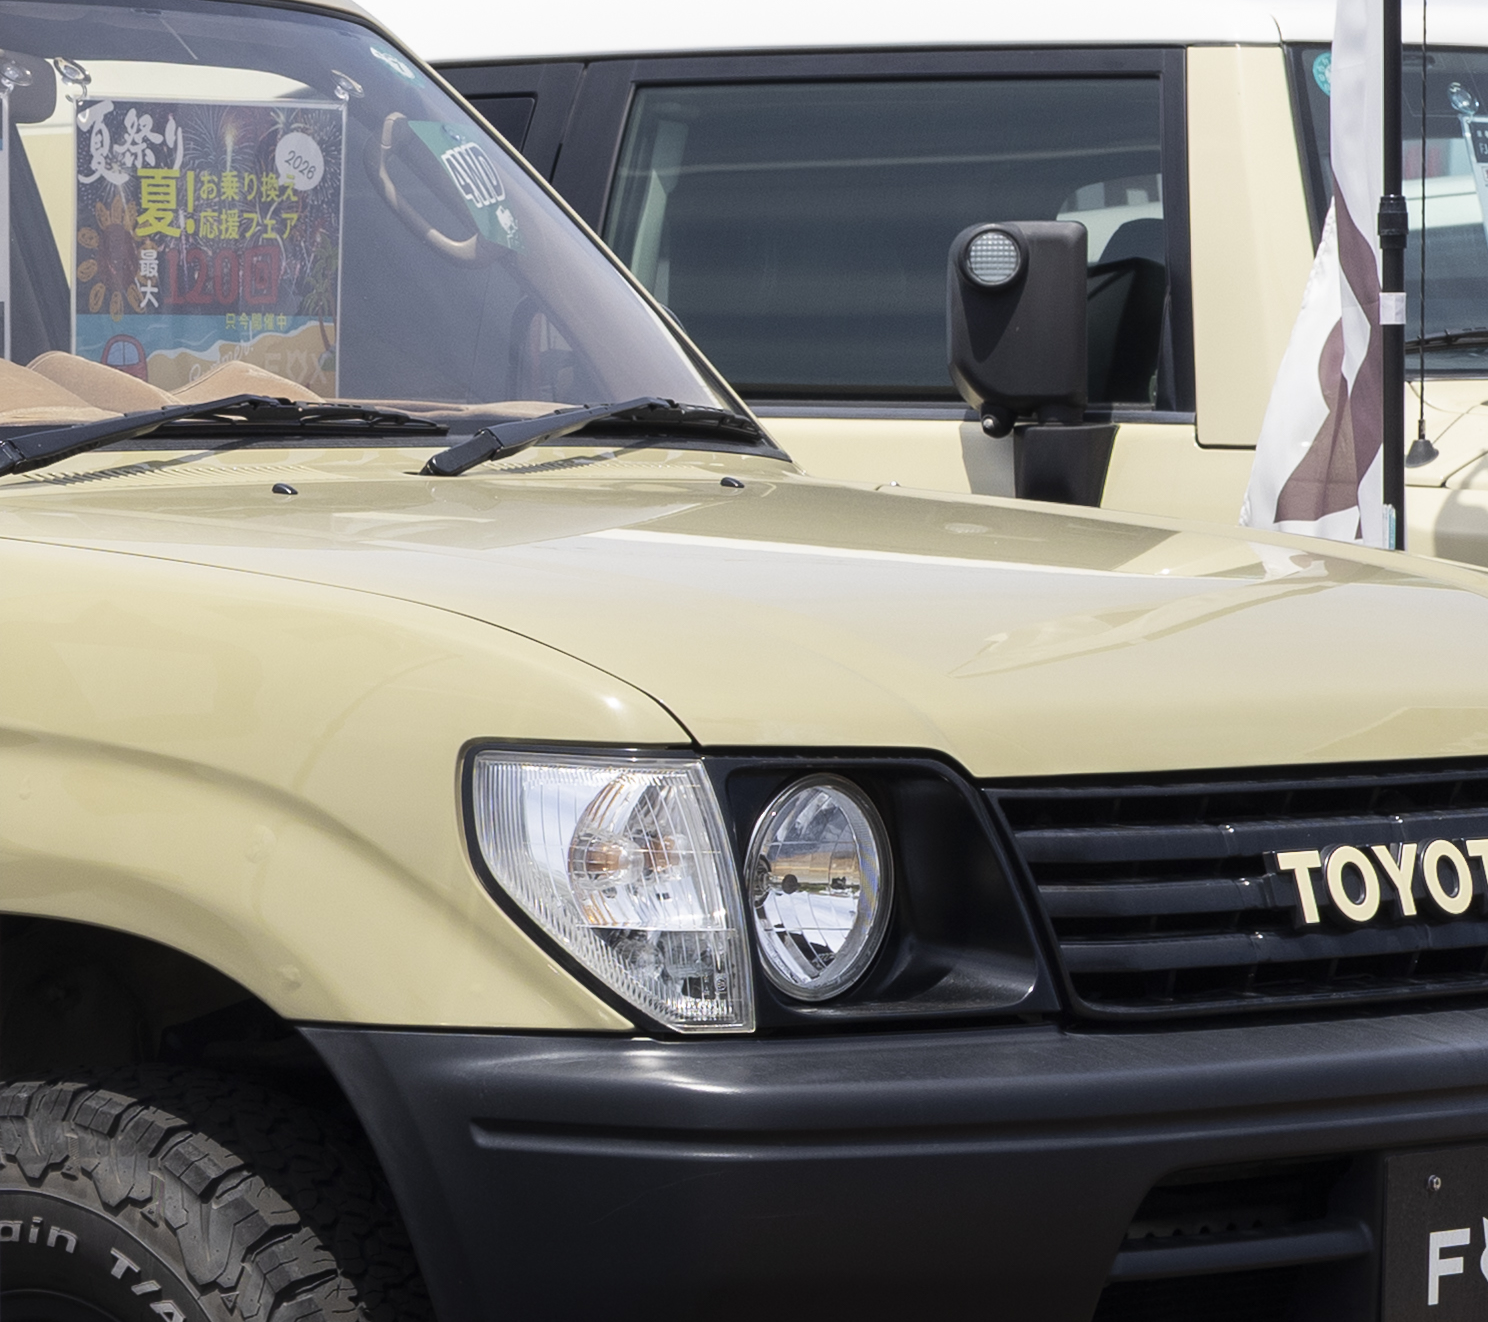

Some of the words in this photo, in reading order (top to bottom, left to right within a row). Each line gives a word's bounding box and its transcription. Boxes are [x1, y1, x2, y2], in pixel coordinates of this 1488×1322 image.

[76, 99, 184, 184] 夏祭り
[284, 149, 317, 181] 2026
[136, 168, 195, 238] 夏!
[199, 170, 299, 203] お乗り換え
[440, 141, 506, 208] 4WD
[198, 209, 299, 240] 応援フェア
[139, 248, 159, 309] 最大
